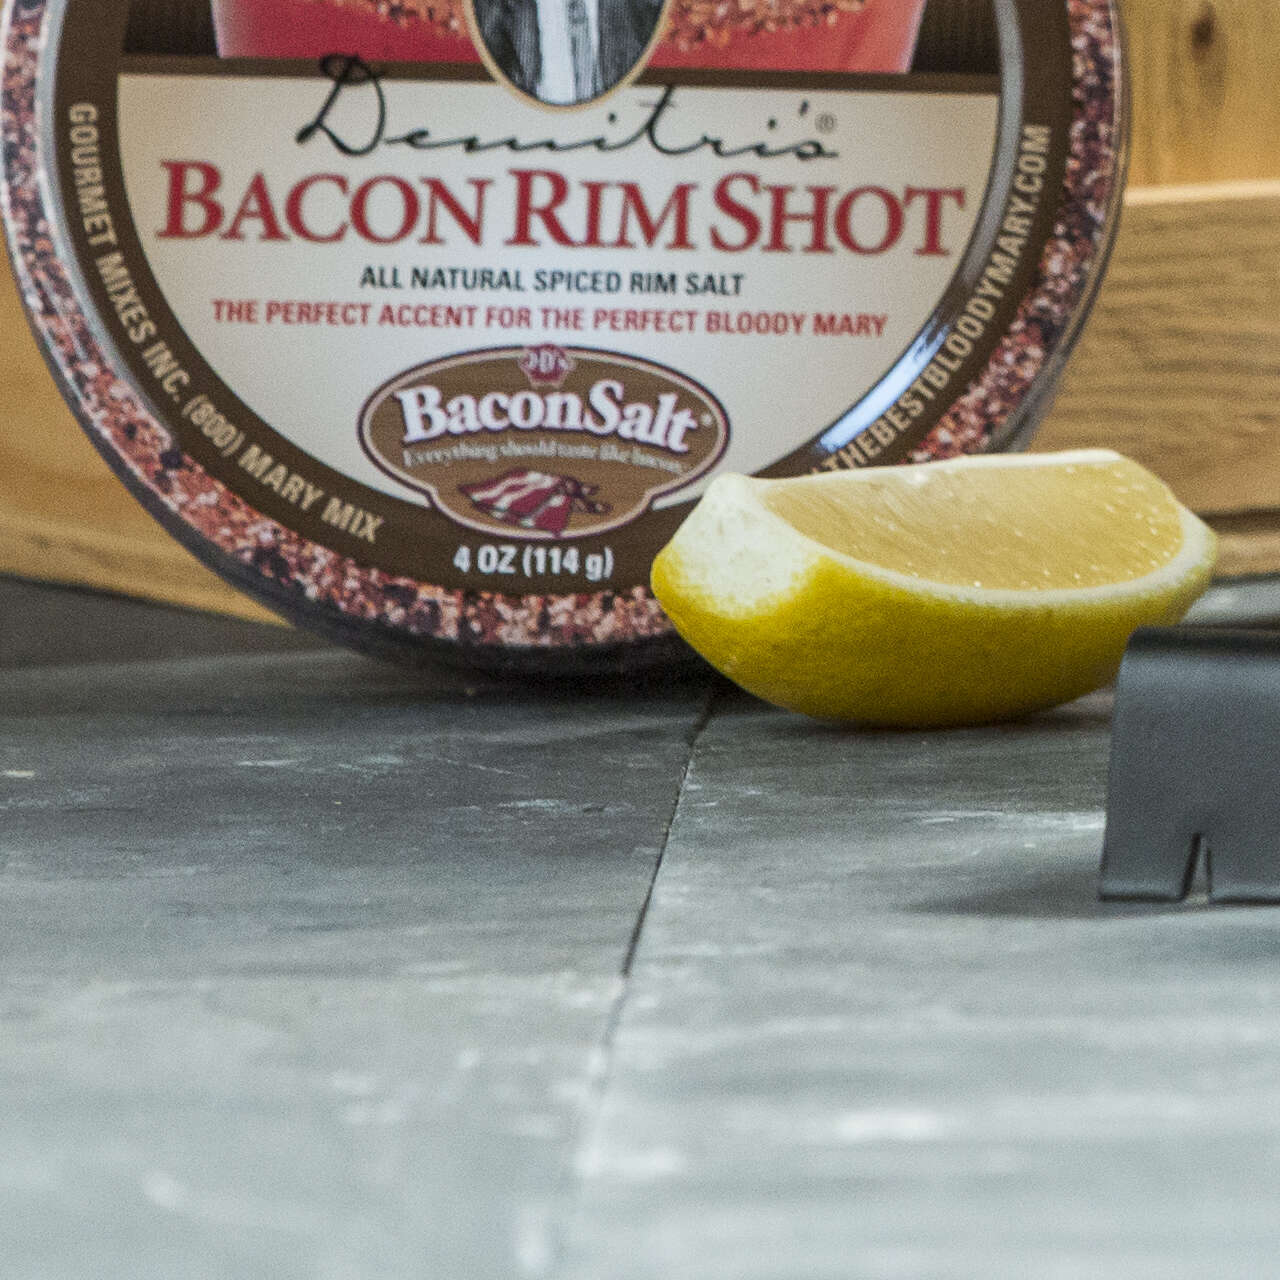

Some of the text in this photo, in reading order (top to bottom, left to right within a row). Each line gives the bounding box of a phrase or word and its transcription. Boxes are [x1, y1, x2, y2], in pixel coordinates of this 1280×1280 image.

[69, 102, 119, 250] GOURMET
[155, 158, 967, 257] BACON RIM SHOT
[97, 251, 192, 403] MIXES INC.
[212, 299, 888, 337] THE PERFECT ACCENT FOR THE PERFECT BLOODY MARY
[359, 267, 745, 295] ALL NATURAL SPICED RIM SALT
[813, 124, 1051, 474] THEBESTBLOODYMARY.COM
[238, 446, 326, 511] MARY
[320, 500, 384, 543] MIX
[453, 545, 614, 582] 4 OZ (114 g)
